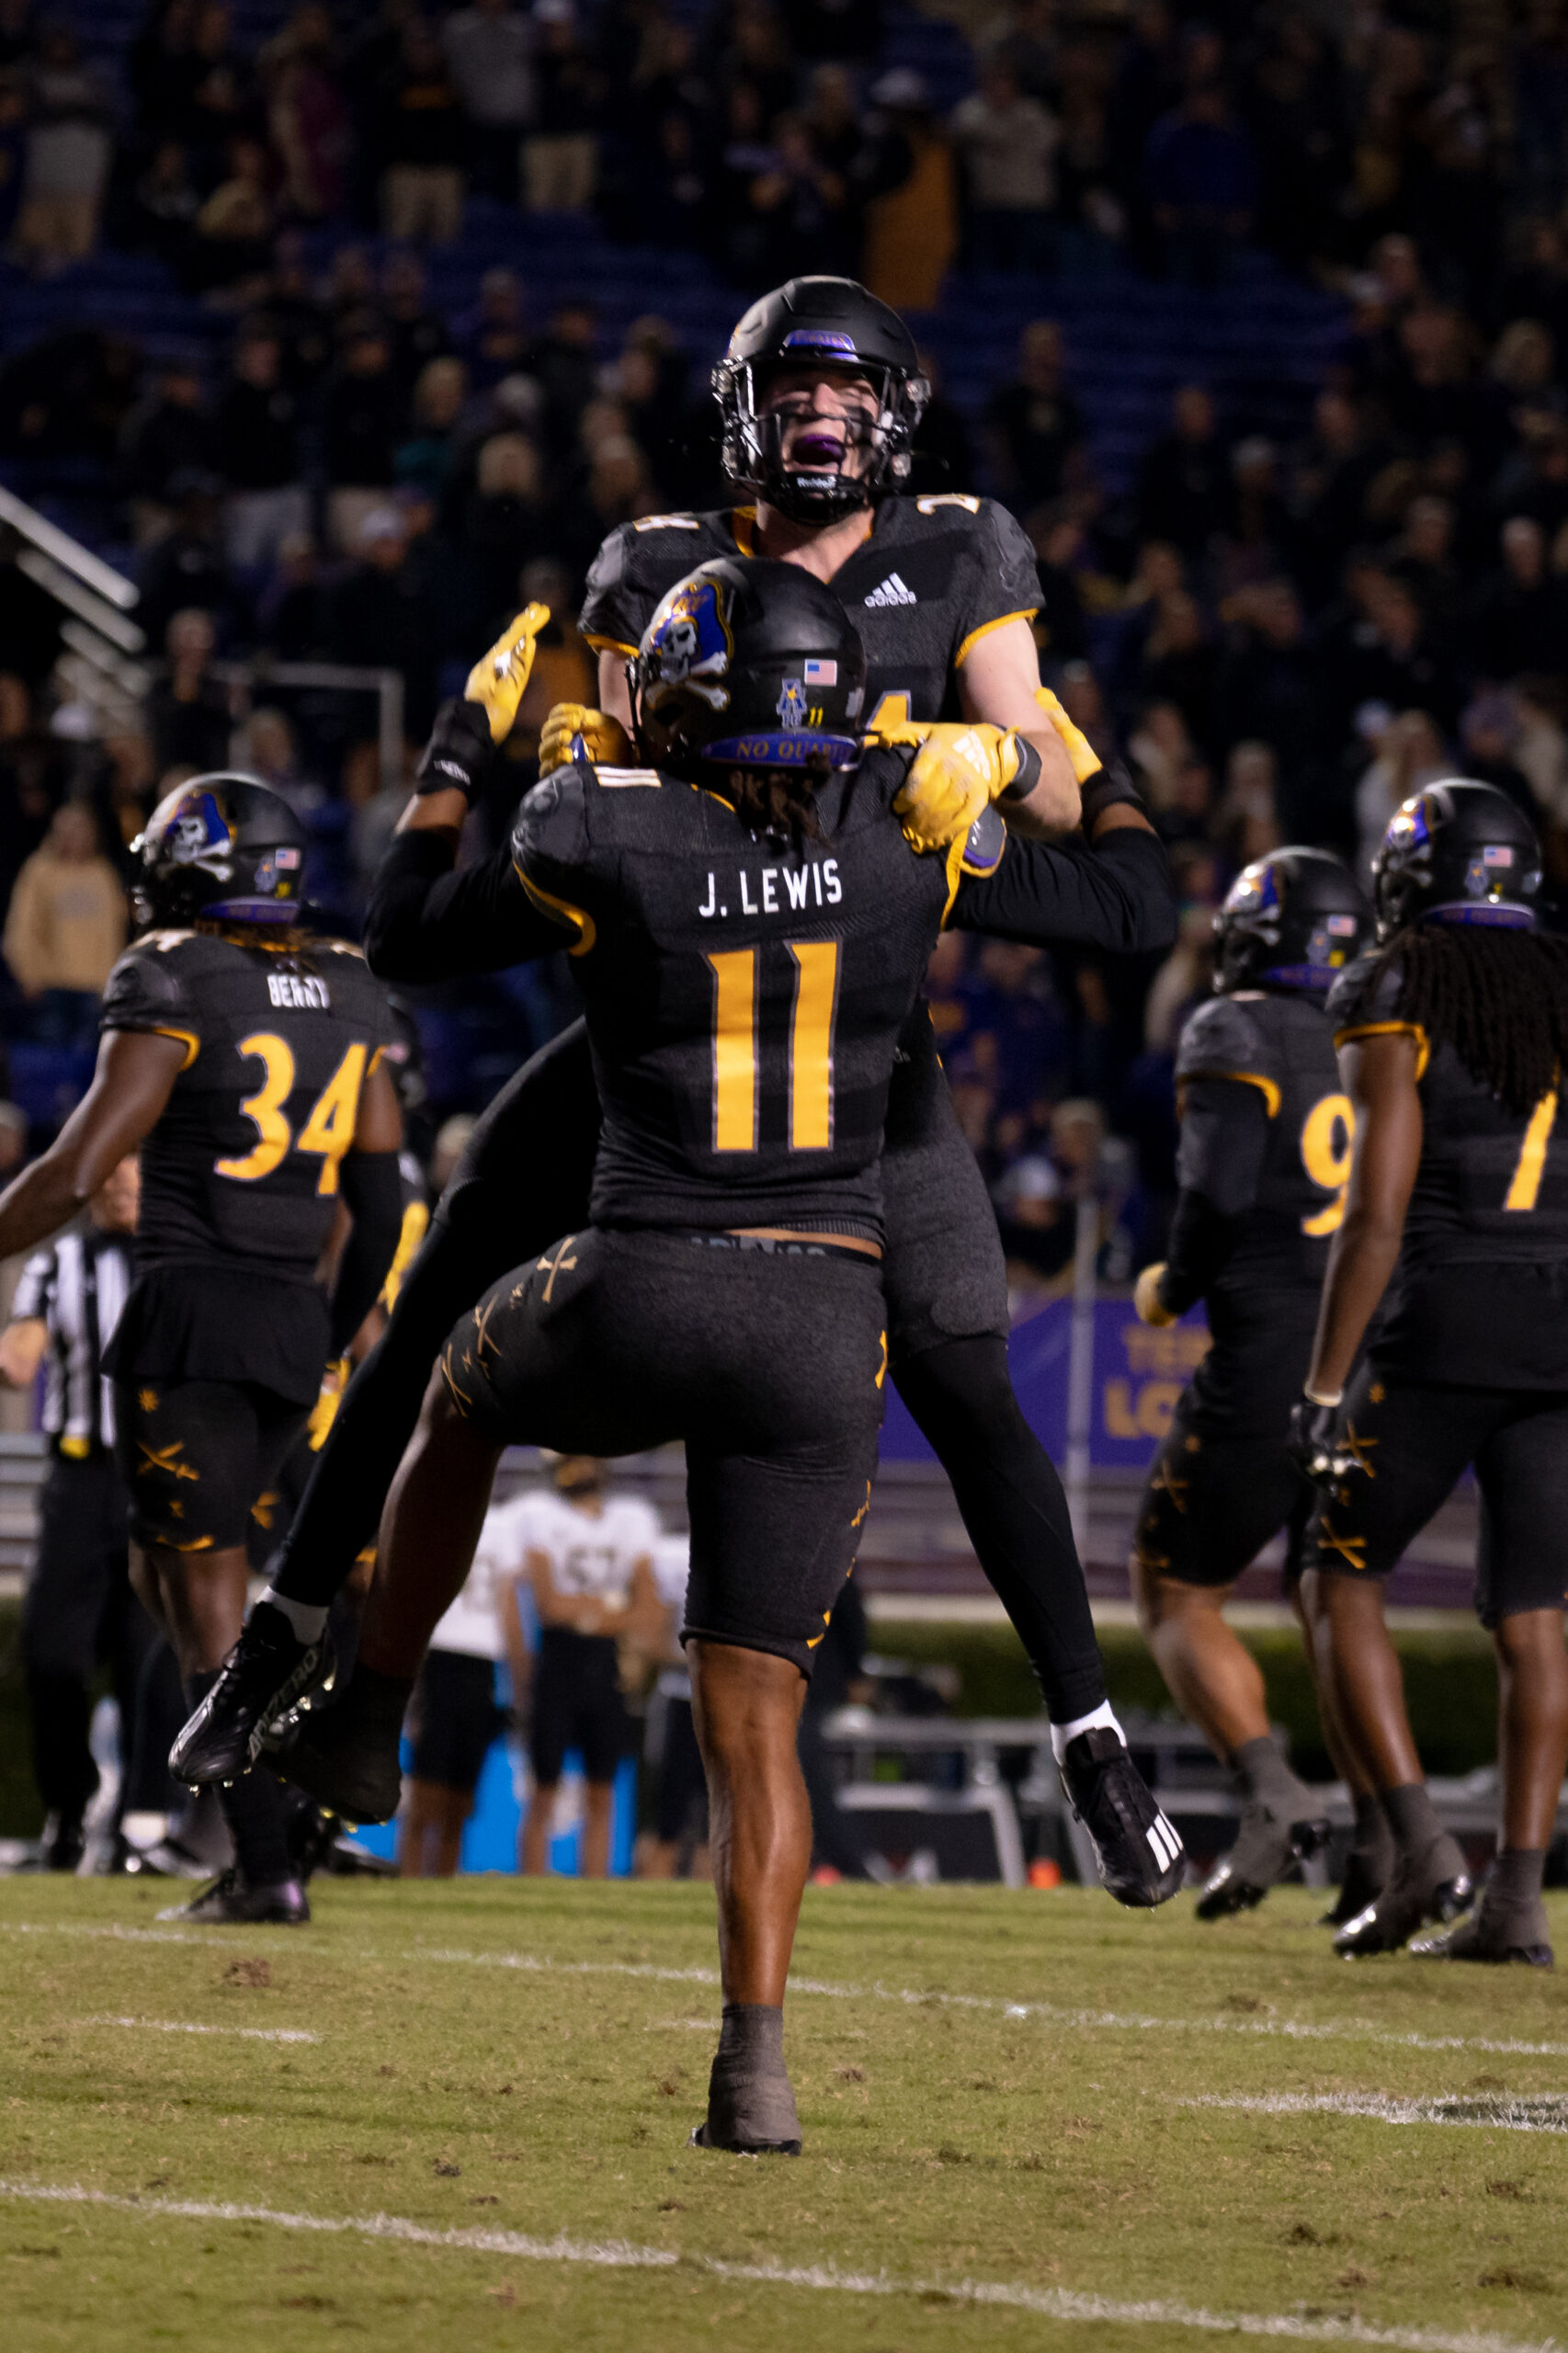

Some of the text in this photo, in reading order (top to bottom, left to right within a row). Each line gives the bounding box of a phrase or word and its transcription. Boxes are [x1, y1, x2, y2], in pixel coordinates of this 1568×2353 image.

[865, 591, 917, 608] adidas
[808, 706, 824, 728] 11
[737, 740, 770, 757] NO
[699, 858, 842, 917] J. LEWIS
[699, 936, 842, 1154] 11
[213, 1030, 367, 1197] 34
